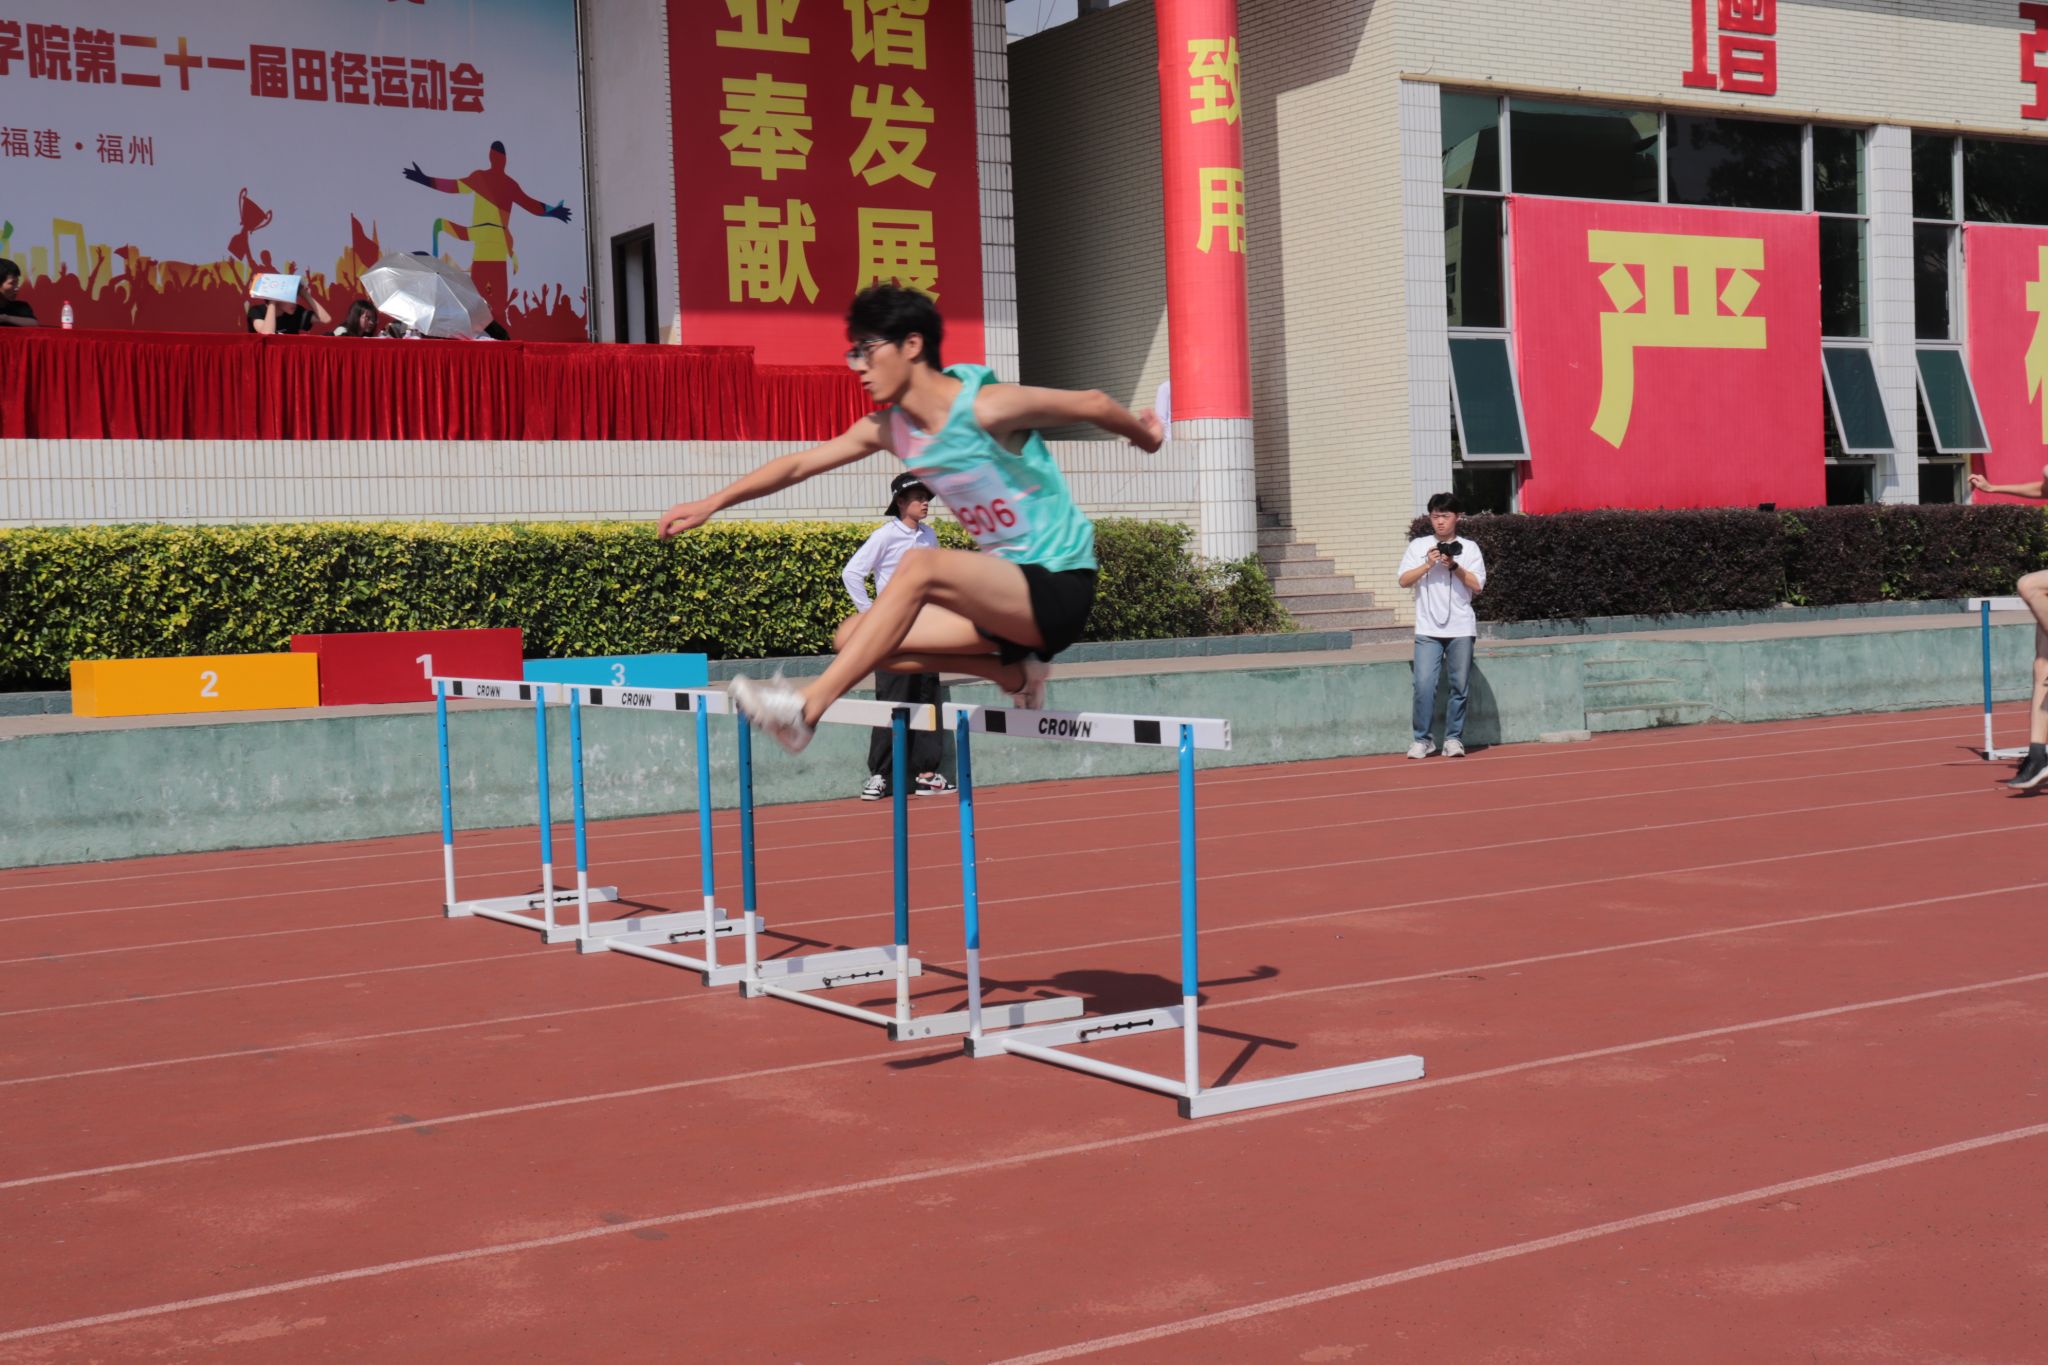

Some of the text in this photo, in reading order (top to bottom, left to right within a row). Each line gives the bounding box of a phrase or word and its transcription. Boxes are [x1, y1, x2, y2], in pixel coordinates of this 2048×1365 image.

[1587, 229, 1767, 450] 严
[200, 670, 219, 697] 2
[610, 663, 626, 687] 3
[476, 684, 500, 697] CROWN
[621, 692, 652, 707] CROWN
[1038, 717, 1092, 738] CROWN
